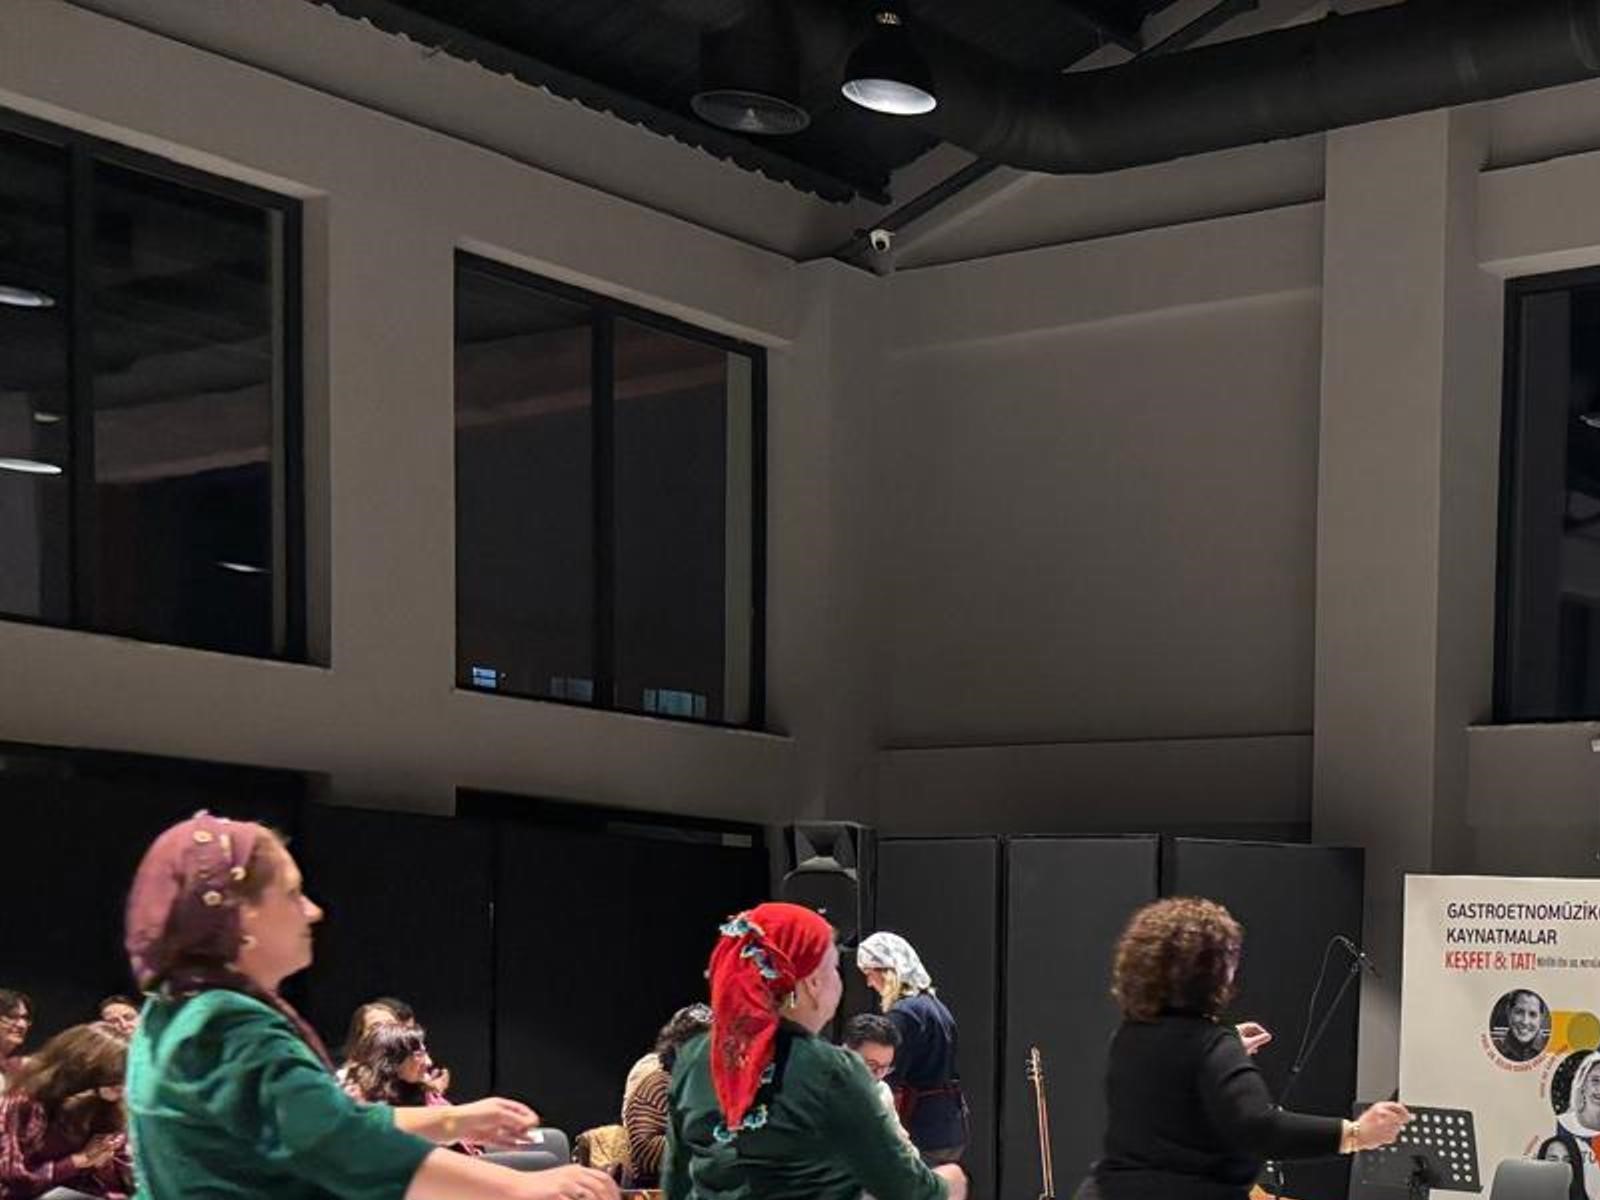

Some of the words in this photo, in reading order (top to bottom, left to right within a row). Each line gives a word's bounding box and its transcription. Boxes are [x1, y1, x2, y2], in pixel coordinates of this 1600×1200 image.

[1446, 928, 1557, 945] KAYNATMALAR
[1445, 951, 1491, 971] KEŞFET
[1494, 951, 1505, 970] &
